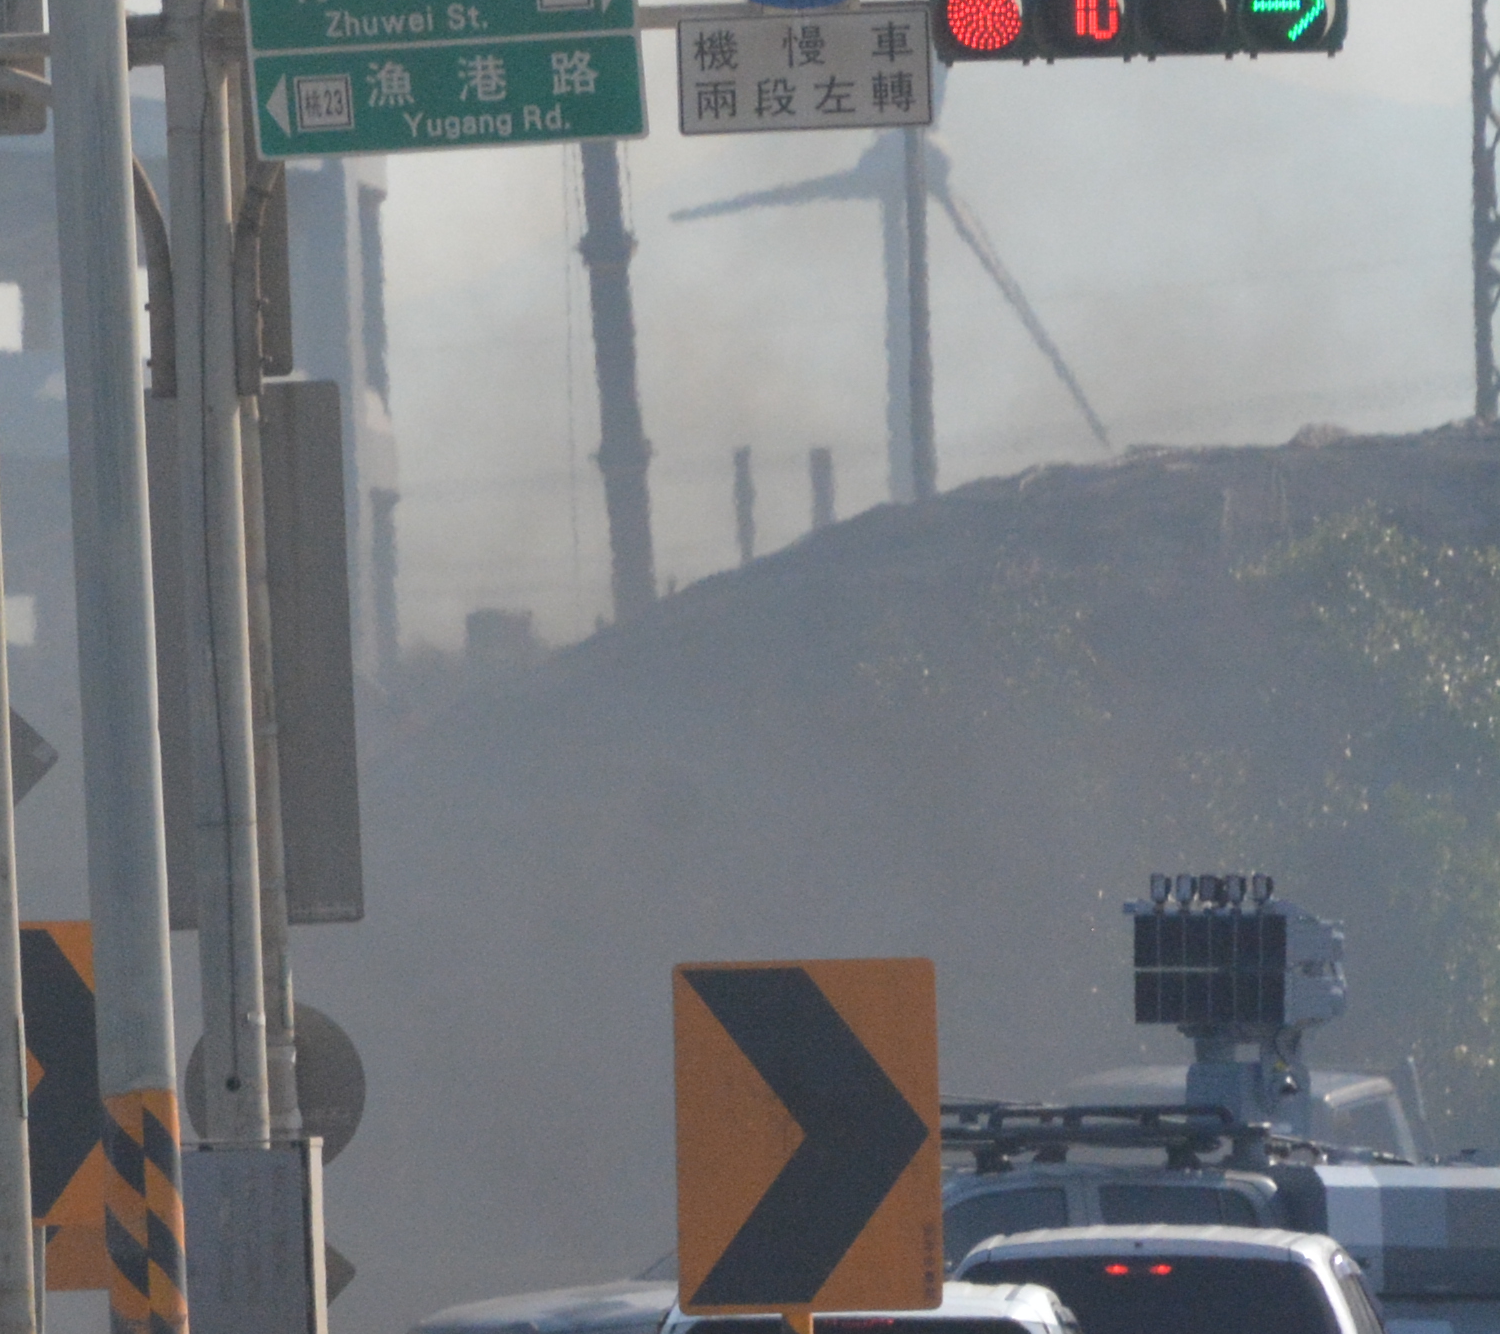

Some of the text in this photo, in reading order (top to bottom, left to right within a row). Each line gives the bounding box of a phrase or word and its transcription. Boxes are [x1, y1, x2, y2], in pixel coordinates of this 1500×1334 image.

[326, 3, 488, 38] Zhuwei St.
[694, 21, 914, 71] 機慢車
[366, 50, 599, 108] 漁港路
[694, 71, 916, 120] 兩段左轉
[305, 89, 344, 119] 桃23
[403, 104, 571, 139] Yugang Rd.
